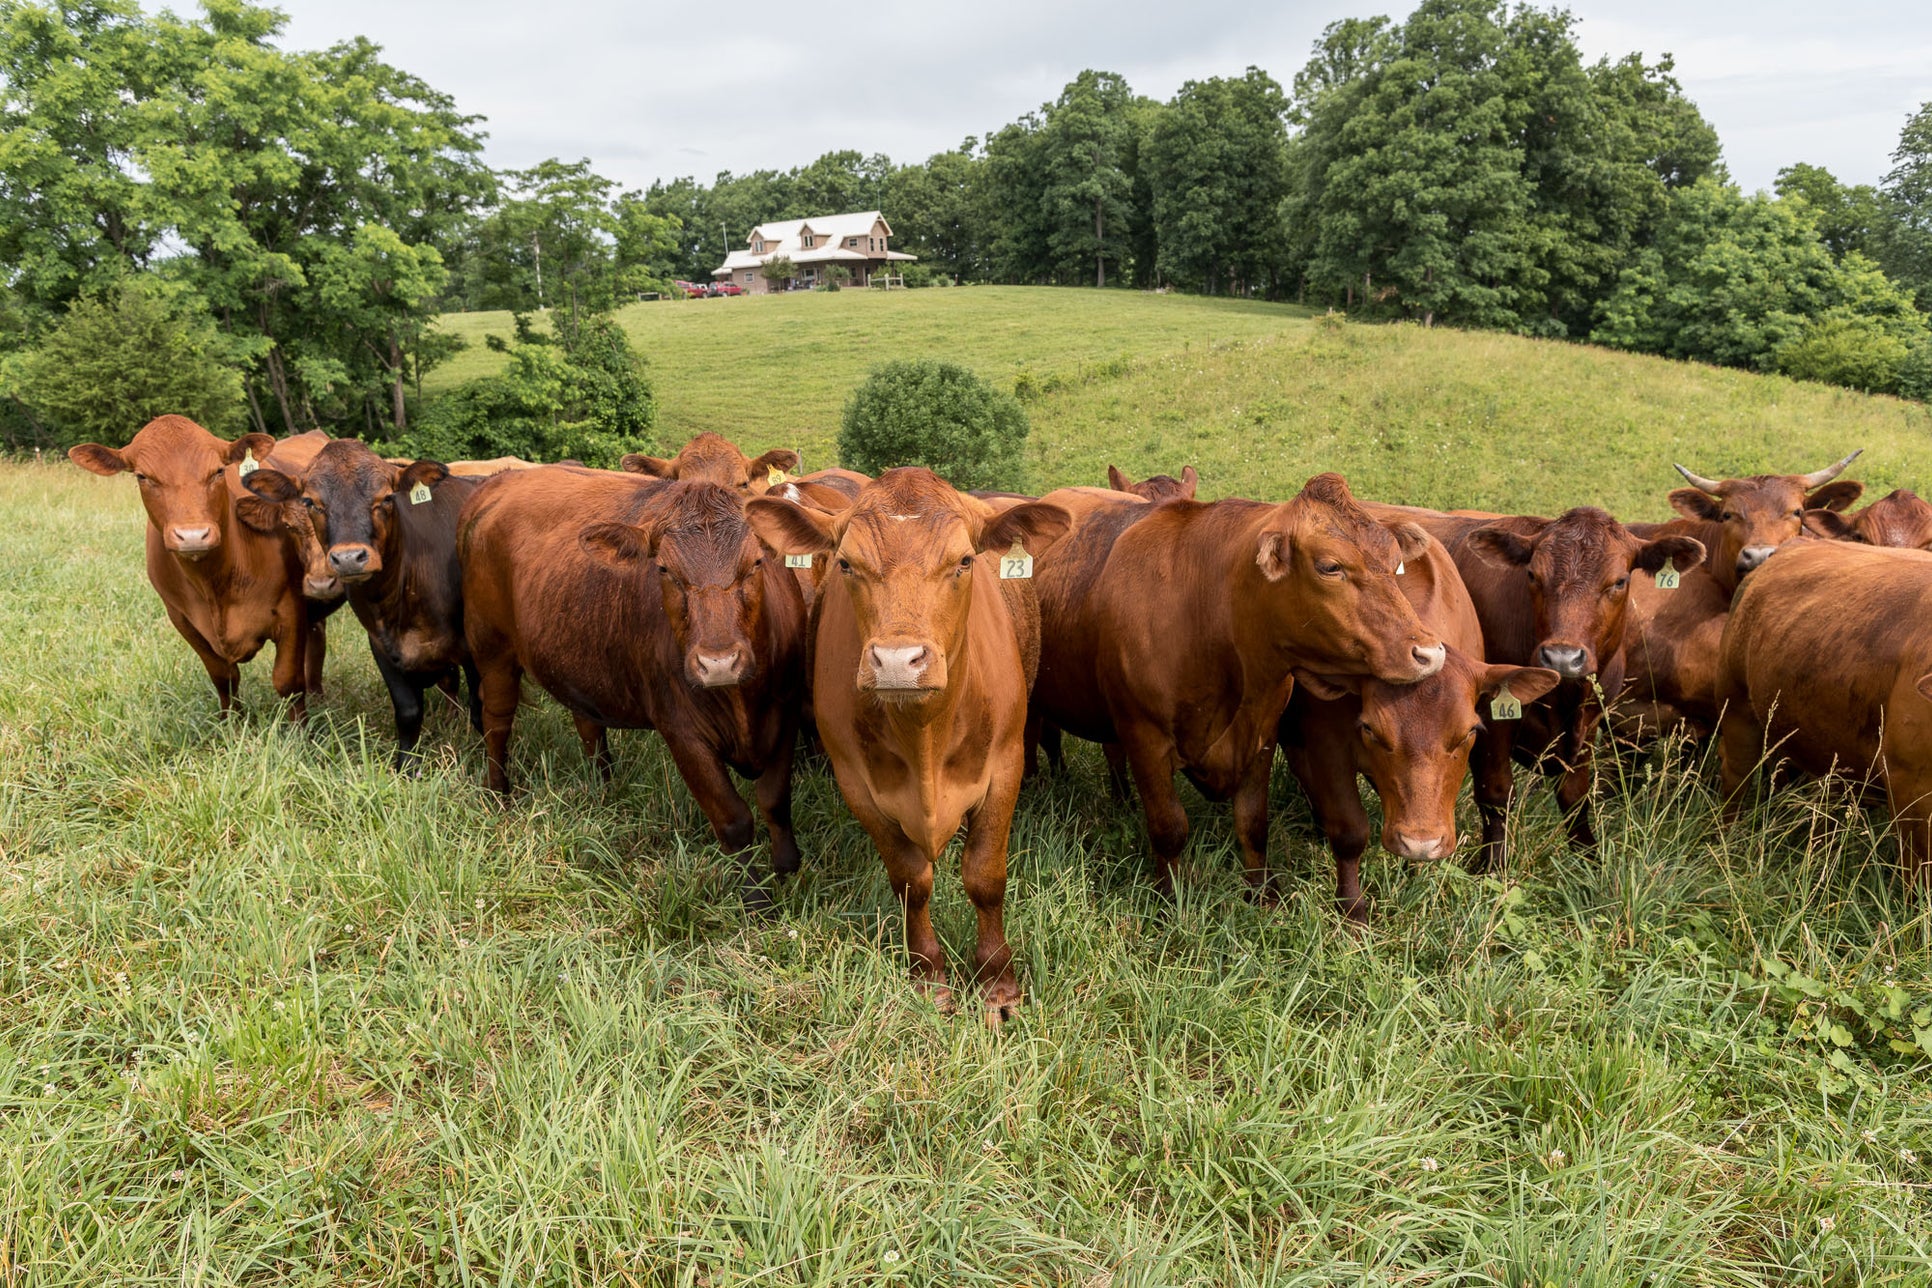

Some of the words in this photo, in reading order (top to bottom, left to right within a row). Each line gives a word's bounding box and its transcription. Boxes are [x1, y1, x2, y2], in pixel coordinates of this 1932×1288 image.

[415, 489, 427, 502] 48
[791, 554, 806, 567] 41
[1006, 559, 1025, 578] 23
[1660, 573, 1675, 588] 76
[1499, 702, 1515, 719] 46
